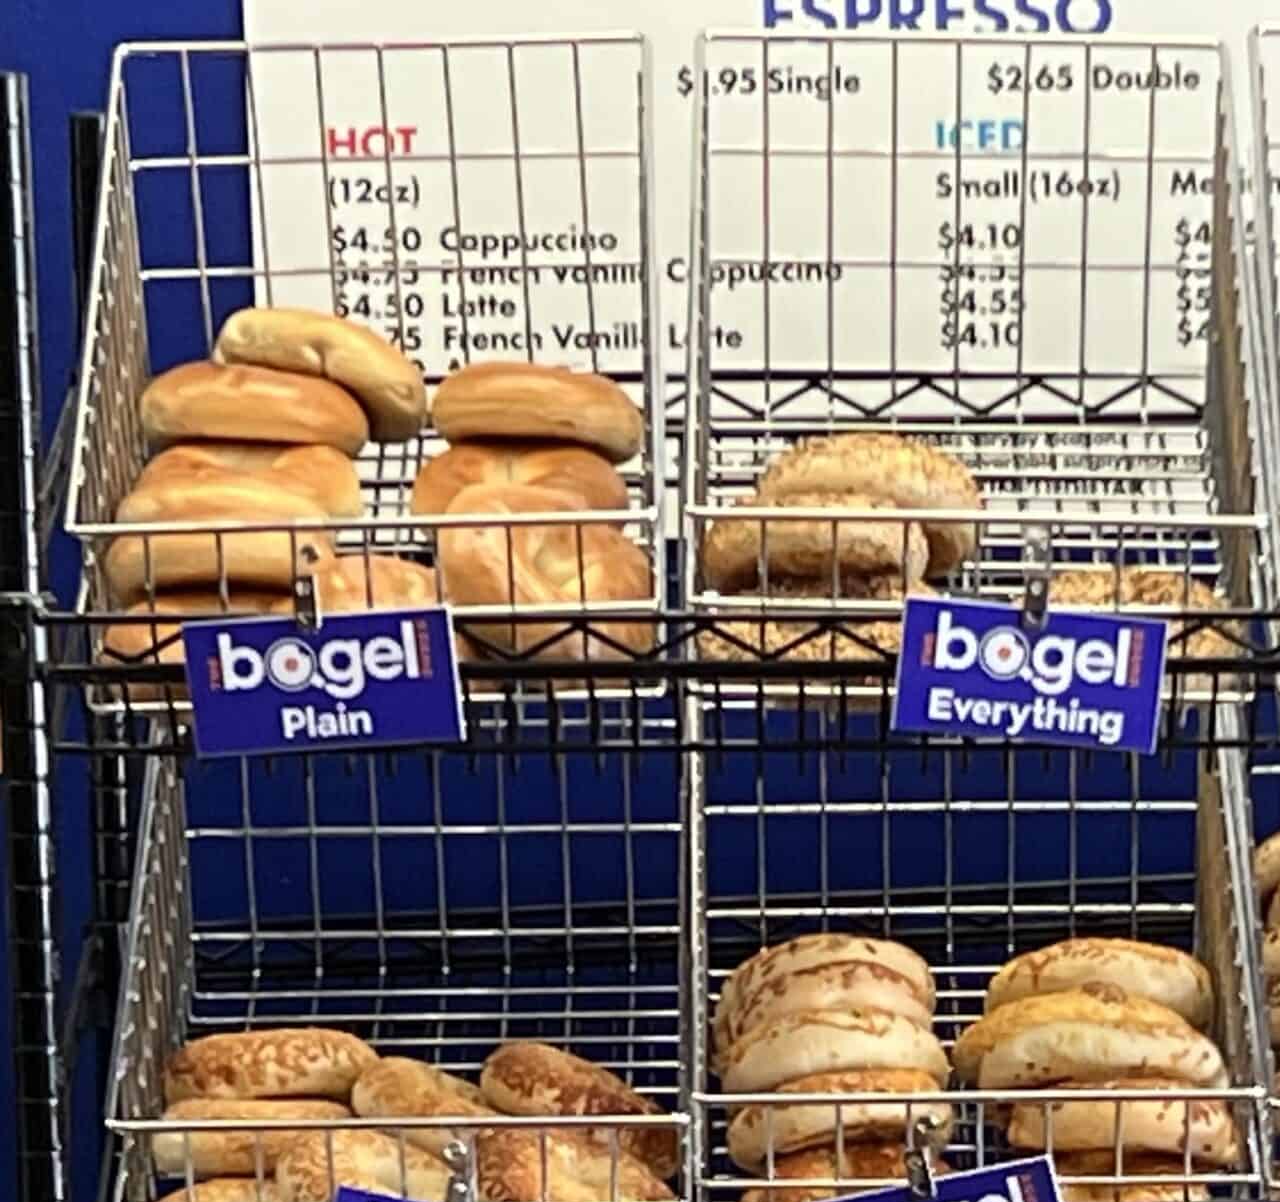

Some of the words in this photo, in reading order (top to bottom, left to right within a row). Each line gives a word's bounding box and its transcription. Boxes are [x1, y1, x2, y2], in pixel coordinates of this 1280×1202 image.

[767, 65, 861, 101] Single
[987, 63, 1073, 93] $2.65
[1093, 63, 1200, 92] Double
[328, 128, 417, 155] HOT
[935, 120, 1025, 150] ICED
[329, 177, 420, 206] (12oz)
[936, 170, 1018, 197] Small
[1030, 169, 1120, 203] (16oz)
[332, 226, 421, 254] $4.50
[440, 225, 618, 259] Cappuccino
[938, 221, 1021, 259] $4.10
[667, 258, 844, 290] Cppuccino
[443, 293, 517, 318] Latte
[443, 325, 543, 351] French
[280, 702, 374, 740] Plain
[927, 687, 1125, 745] Everything
